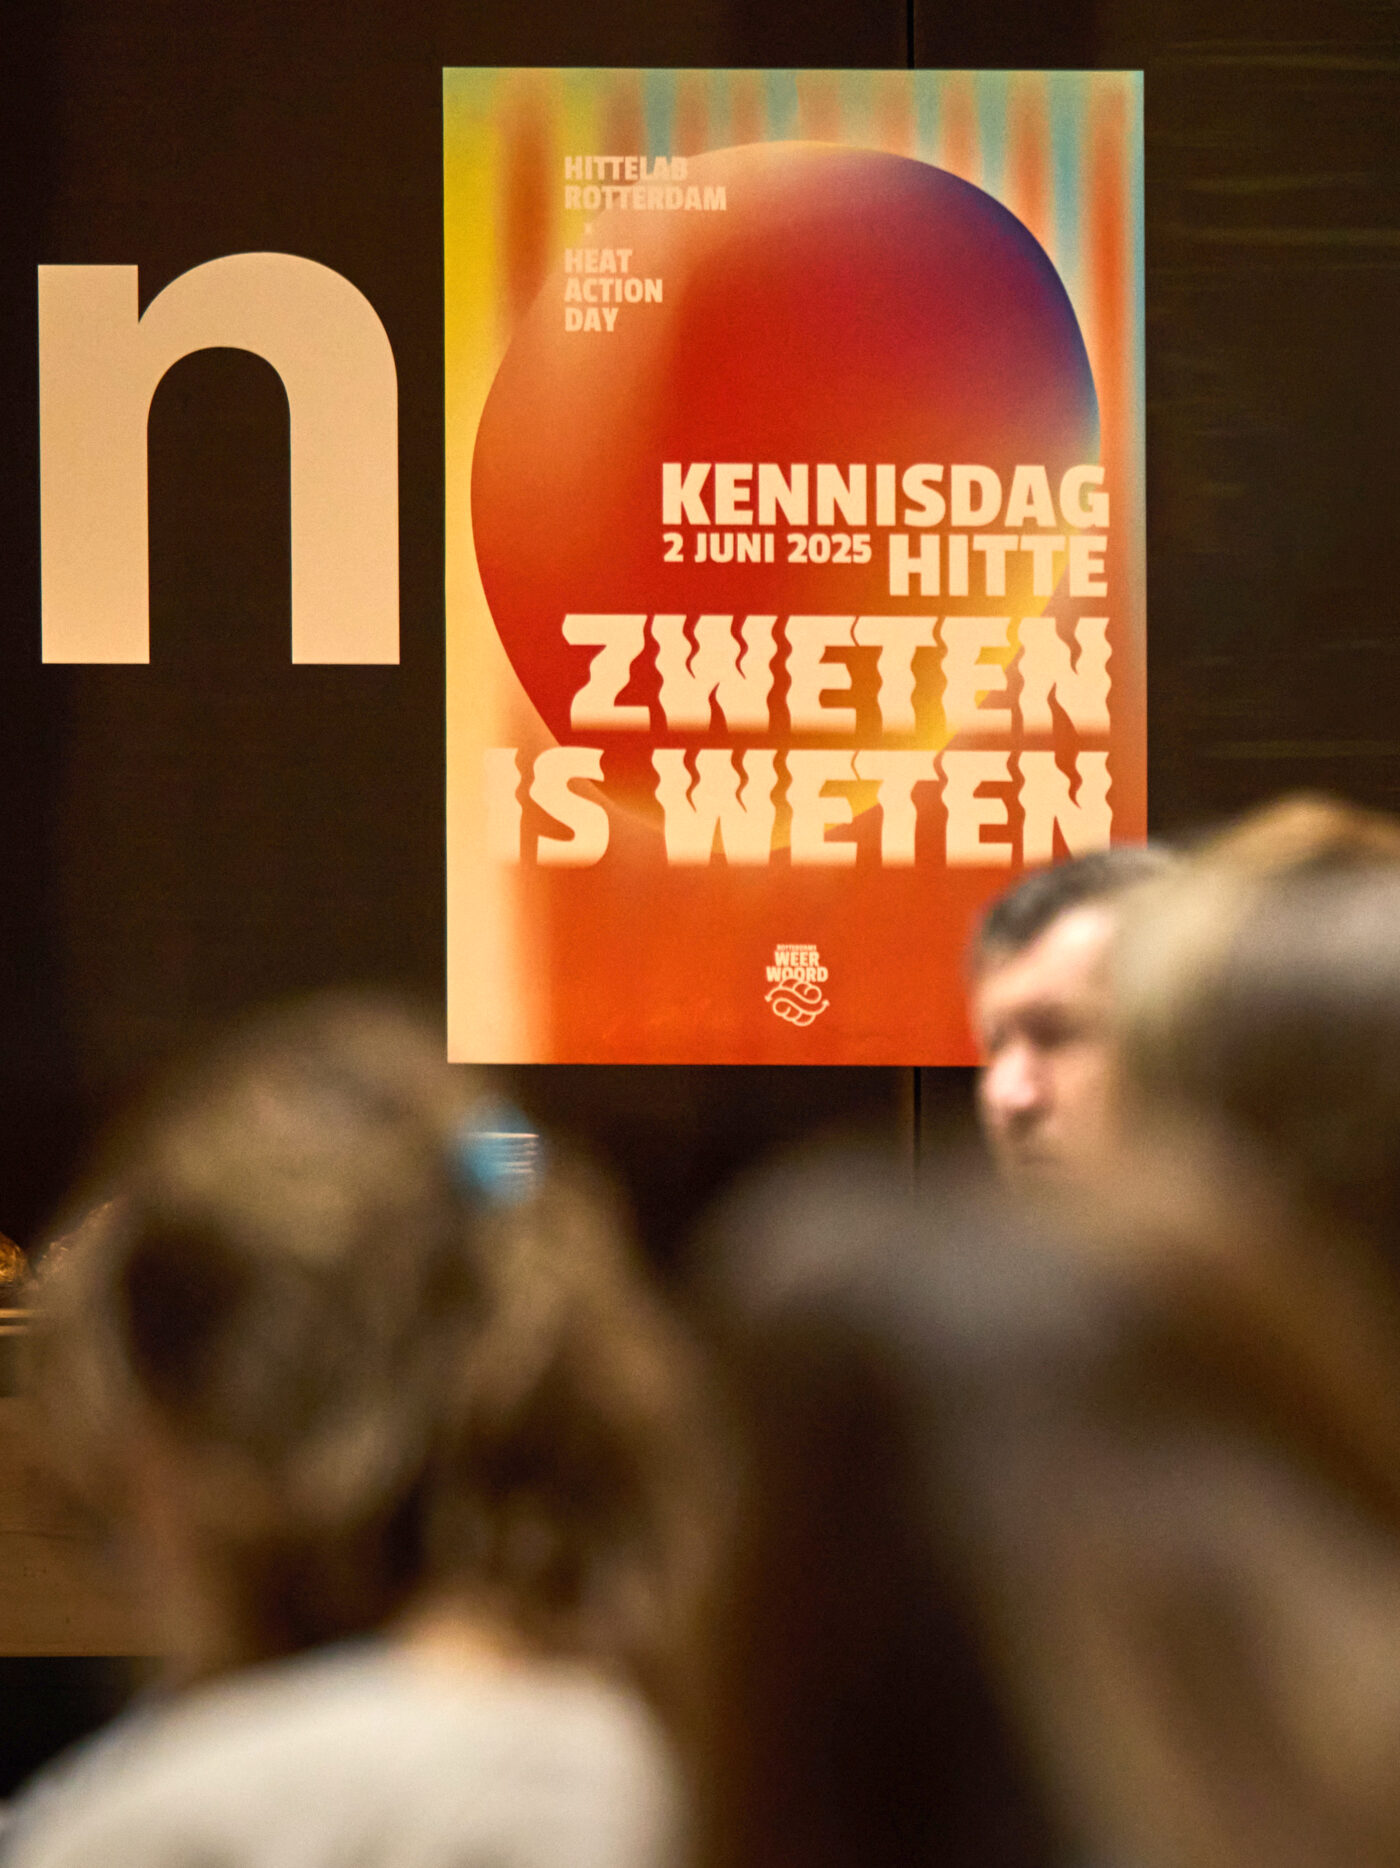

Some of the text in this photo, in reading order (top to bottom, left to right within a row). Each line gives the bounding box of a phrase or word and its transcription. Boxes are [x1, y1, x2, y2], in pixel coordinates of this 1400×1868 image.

[564, 156, 688, 181] HITTELAB
[564, 185, 727, 211] ROTTERDAM
[564, 249, 633, 273] HEAT
[564, 278, 663, 303] ACTION
[564, 307, 619, 332] DAY
[38, 252, 400, 665] n
[661, 463, 1110, 527] KENNISDAG
[663, 533, 872, 564] 2 JUNI 2025
[889, 535, 1108, 597] HITTE
[562, 614, 1112, 734] ZWETEN
[485, 746, 1113, 868] IS WETEN
[774, 951, 820, 966] WEER
[766, 967, 828, 982] WOORD
